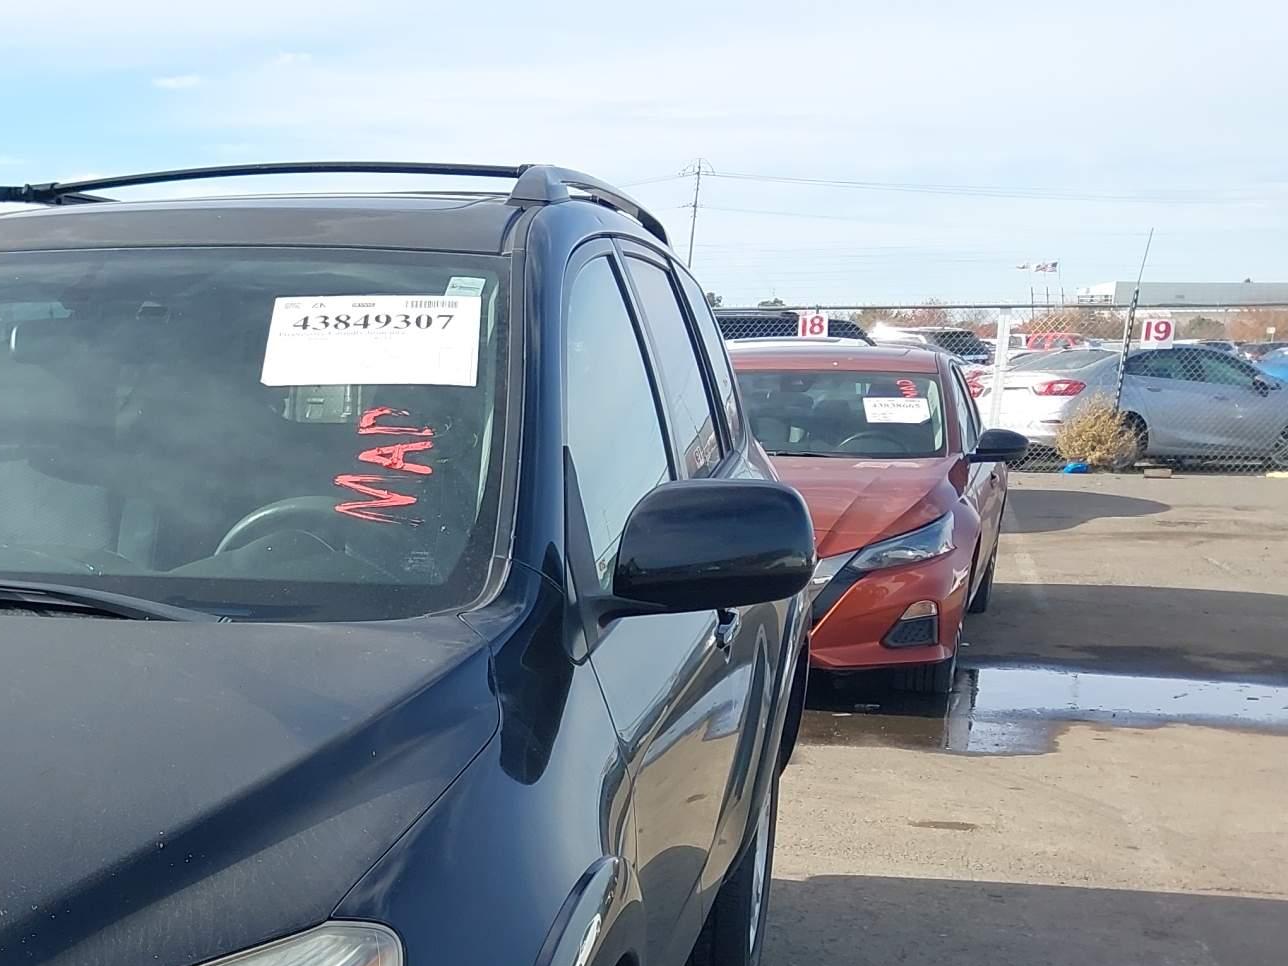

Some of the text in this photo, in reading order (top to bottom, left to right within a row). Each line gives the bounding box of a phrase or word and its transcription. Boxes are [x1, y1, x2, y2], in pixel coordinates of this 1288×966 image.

[292, 313, 455, 331] 43849307
[801, 315, 824, 337] 18
[1144, 320, 1172, 341] 19
